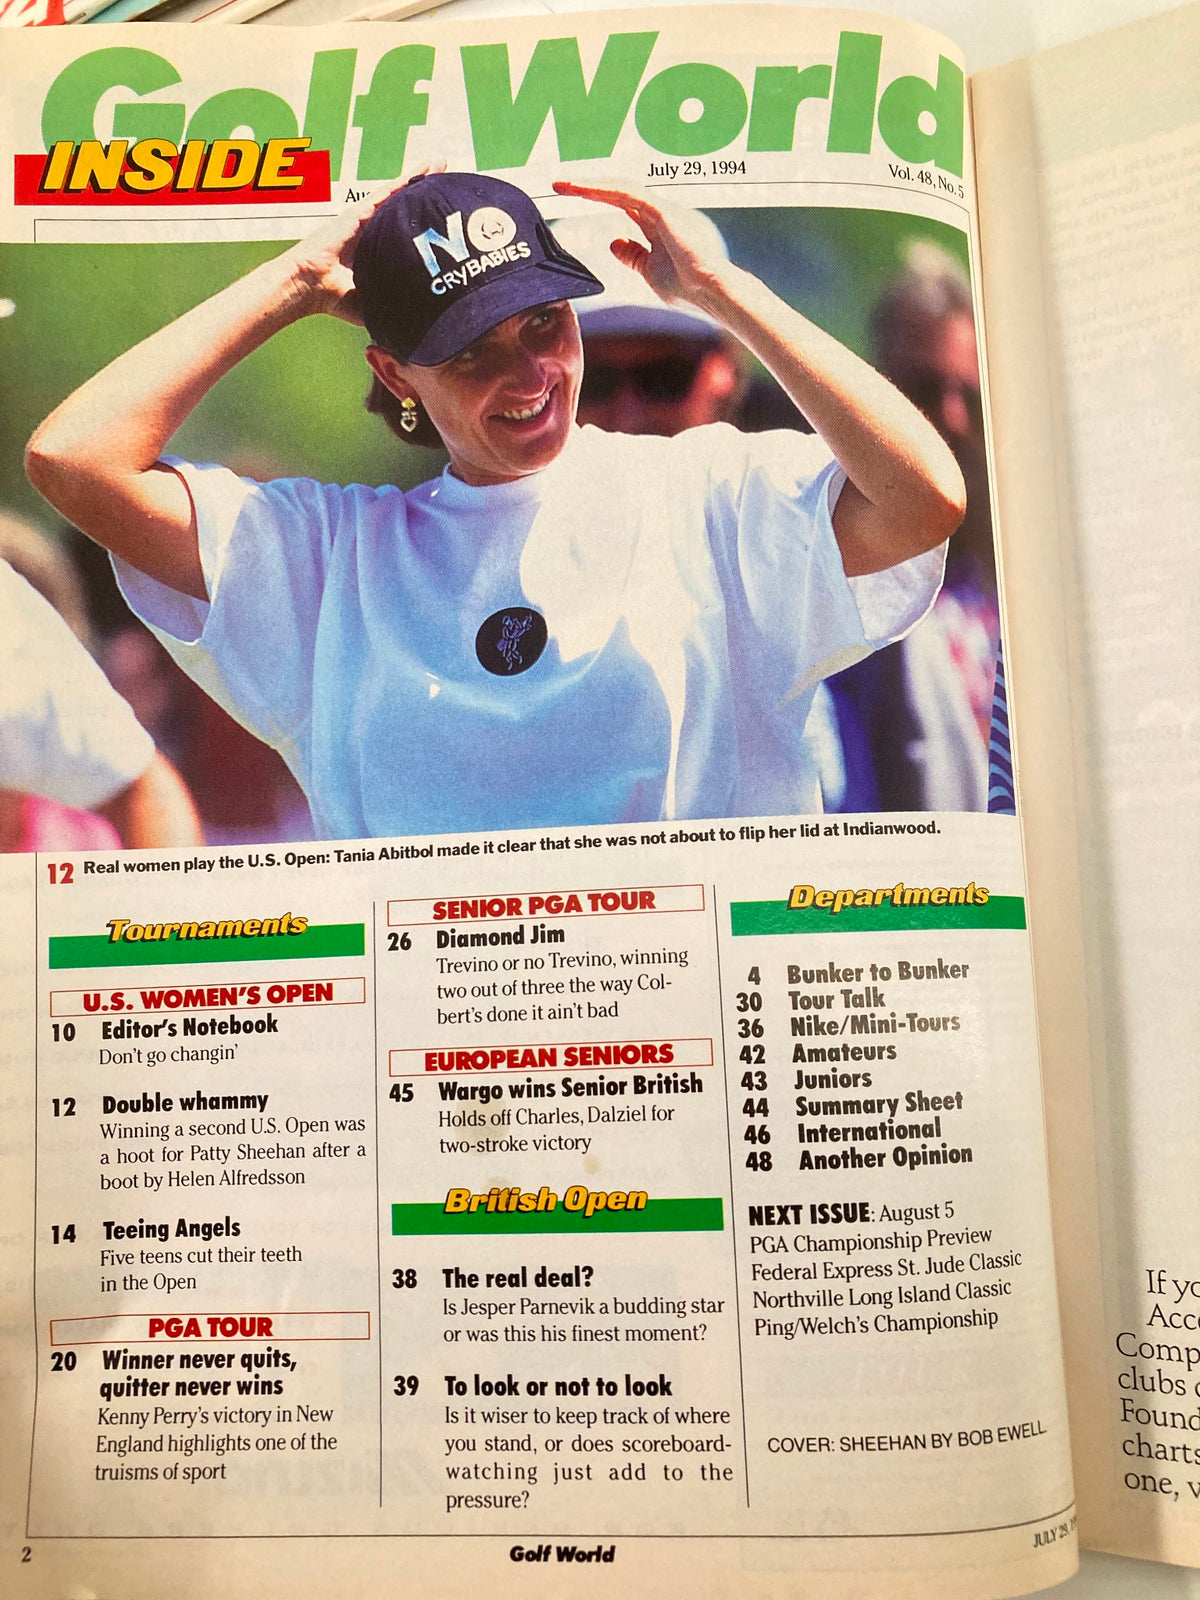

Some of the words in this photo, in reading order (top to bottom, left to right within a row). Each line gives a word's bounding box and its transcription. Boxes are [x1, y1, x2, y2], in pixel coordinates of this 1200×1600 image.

[41, 46, 435, 181] Golf
[460, 31, 963, 179] World
[38, 137, 312, 193] INSIDE
[647, 163, 679, 179] July
[683, 161, 706, 177] 29,
[711, 160, 747, 175] 1994
[888, 164, 914, 181] Vol.
[917, 170, 936, 188] 48,
[938, 175, 957, 195] No.
[958, 185, 965, 199] 5
[412, 206, 517, 278] NO
[83, 860, 119, 874] Real
[123, 858, 180, 872] women
[184, 856, 215, 874] play
[219, 855, 244, 869] the
[248, 854, 280, 867] U.S.
[284, 852, 330, 868] Open:
[334, 848, 374, 863] Tania
[378, 845, 433, 860] Abitbol
[437, 842, 480, 857] made
[484, 841, 494, 854] it
[497, 840, 536, 854] clear
[540, 837, 570, 850] that
[574, 835, 602, 848] she
[606, 835, 637, 846] was
[641, 832, 666, 845] not
[670, 829, 716, 844] about
[719, 828, 736, 841] to
[739, 826, 765, 842] flip
[769, 825, 797, 839] her
[800, 824, 820, 837] lid
[823, 824, 840, 836] at
[844, 821, 941, 836] Indianwood.
[47, 862, 75, 885] 12
[433, 900, 523, 920] SENIOR
[528, 894, 583, 915] PGA
[587, 890, 656, 912] TOUR
[788, 882, 990, 915] Departments
[106, 912, 309, 945] Tournaments
[388, 932, 411, 951] 26
[437, 924, 524, 948] Diamond
[531, 924, 564, 944] Jim
[436, 957, 498, 973] Trevino
[503, 959, 519, 970] or
[525, 958, 544, 969] no
[549, 952, 616, 968] Trevino,
[620, 948, 688, 967] winning
[748, 967, 761, 985] 4
[788, 962, 863, 984] Bunker
[870, 964, 891, 981] to
[898, 958, 969, 980] Bunker
[84, 992, 133, 1012] U.S.
[267, 983, 333, 1004] OPEN
[736, 992, 762, 1012] 30
[788, 991, 834, 1010] Tour
[841, 987, 885, 1008] Talk
[52, 1023, 75, 1042] 10
[184, 1013, 278, 1036] Notebook
[738, 1019, 764, 1038] 36
[791, 1012, 960, 1036] Nike/Mini-Tours
[147, 1051, 166, 1067] go
[425, 1048, 557, 1071] EUROPEAN
[564, 1043, 674, 1066] SENIORS
[740, 1044, 765, 1064] 42
[792, 1044, 896, 1063] Amateurs
[389, 1083, 414, 1102] 45
[438, 1082, 503, 1104] Wargo
[508, 1077, 556, 1098] wins
[562, 1075, 627, 1097] Senior
[633, 1072, 703, 1094] British
[741, 1071, 767, 1091] 43
[795, 1067, 872, 1089] Juniors
[52, 1098, 75, 1117] 12
[103, 1092, 173, 1114] Double
[180, 1090, 268, 1112] whammy
[439, 1110, 486, 1127] Holds
[491, 1109, 511, 1126] off
[516, 1108, 583, 1125] Charles,
[588, 1105, 646, 1122] Dalziel
[652, 1105, 675, 1121] for
[743, 1098, 769, 1117] 44
[796, 1096, 899, 1117] Summary
[905, 1090, 963, 1112] Sheet
[744, 1125, 770, 1144] 46
[798, 1116, 941, 1143] International
[440, 1135, 528, 1153] two-stroke
[533, 1135, 591, 1154] victory
[746, 1151, 772, 1171] 48
[799, 1147, 886, 1170] Another
[893, 1143, 972, 1170] Opinion
[444, 1186, 558, 1214] British
[563, 1185, 648, 1218] Open
[749, 1205, 803, 1226] NEXT
[810, 1202, 875, 1224] ISSUE:
[880, 1204, 940, 1225] August
[945, 1201, 954, 1218] 5
[52, 1224, 76, 1244] 14
[103, 1219, 169, 1242] Teeing
[175, 1216, 240, 1241] Angels
[751, 1236, 789, 1253] PGA
[794, 1231, 922, 1255] Championship
[927, 1227, 992, 1246] Preview
[392, 1269, 417, 1288] 38
[442, 1267, 479, 1288] The
[486, 1266, 527, 1288] real
[535, 1265, 593, 1287] deal?
[752, 1263, 817, 1280] Federal
[823, 1262, 893, 1283] Express
[898, 1258, 920, 1276] St.
[925, 1256, 964, 1274] Jude
[970, 1249, 1022, 1271] Classic
[754, 1290, 843, 1308] Northville
[849, 1289, 893, 1309] Long
[898, 1284, 951, 1303] Island
[956, 1279, 1011, 1300] Classic
[1146, 1269, 1166, 1295] If
[149, 1318, 202, 1338] PGA
[207, 1317, 273, 1337] TOUR
[874, 1307, 998, 1336] Championship
[51, 1351, 76, 1371] 20
[103, 1348, 174, 1370] Winner
[180, 1354, 235, 1368] never
[241, 1346, 296, 1372] quits,
[100, 1375, 170, 1402] quitter
[175, 1381, 231, 1396] never
[237, 1374, 283, 1395] wins
[394, 1375, 419, 1396] 39
[445, 1376, 467, 1396] To
[474, 1374, 520, 1396] look
[526, 1381, 548, 1396] or
[555, 1378, 590, 1396] not
[596, 1378, 618, 1396] to
[625, 1374, 672, 1396] look
[1118, 1366, 1186, 1396] clubs
[768, 1437, 834, 1453] COVER:
[840, 1434, 926, 1452] SHEEHAN
[931, 1433, 952, 1448] BY
[958, 1429, 993, 1447] BOB
[997, 1420, 1047, 1442] EWELL
[1124, 1472, 1179, 1502] one,
[21, 1547, 32, 1562] 2
[510, 1545, 551, 1563] Golf
[556, 1545, 617, 1563] World
